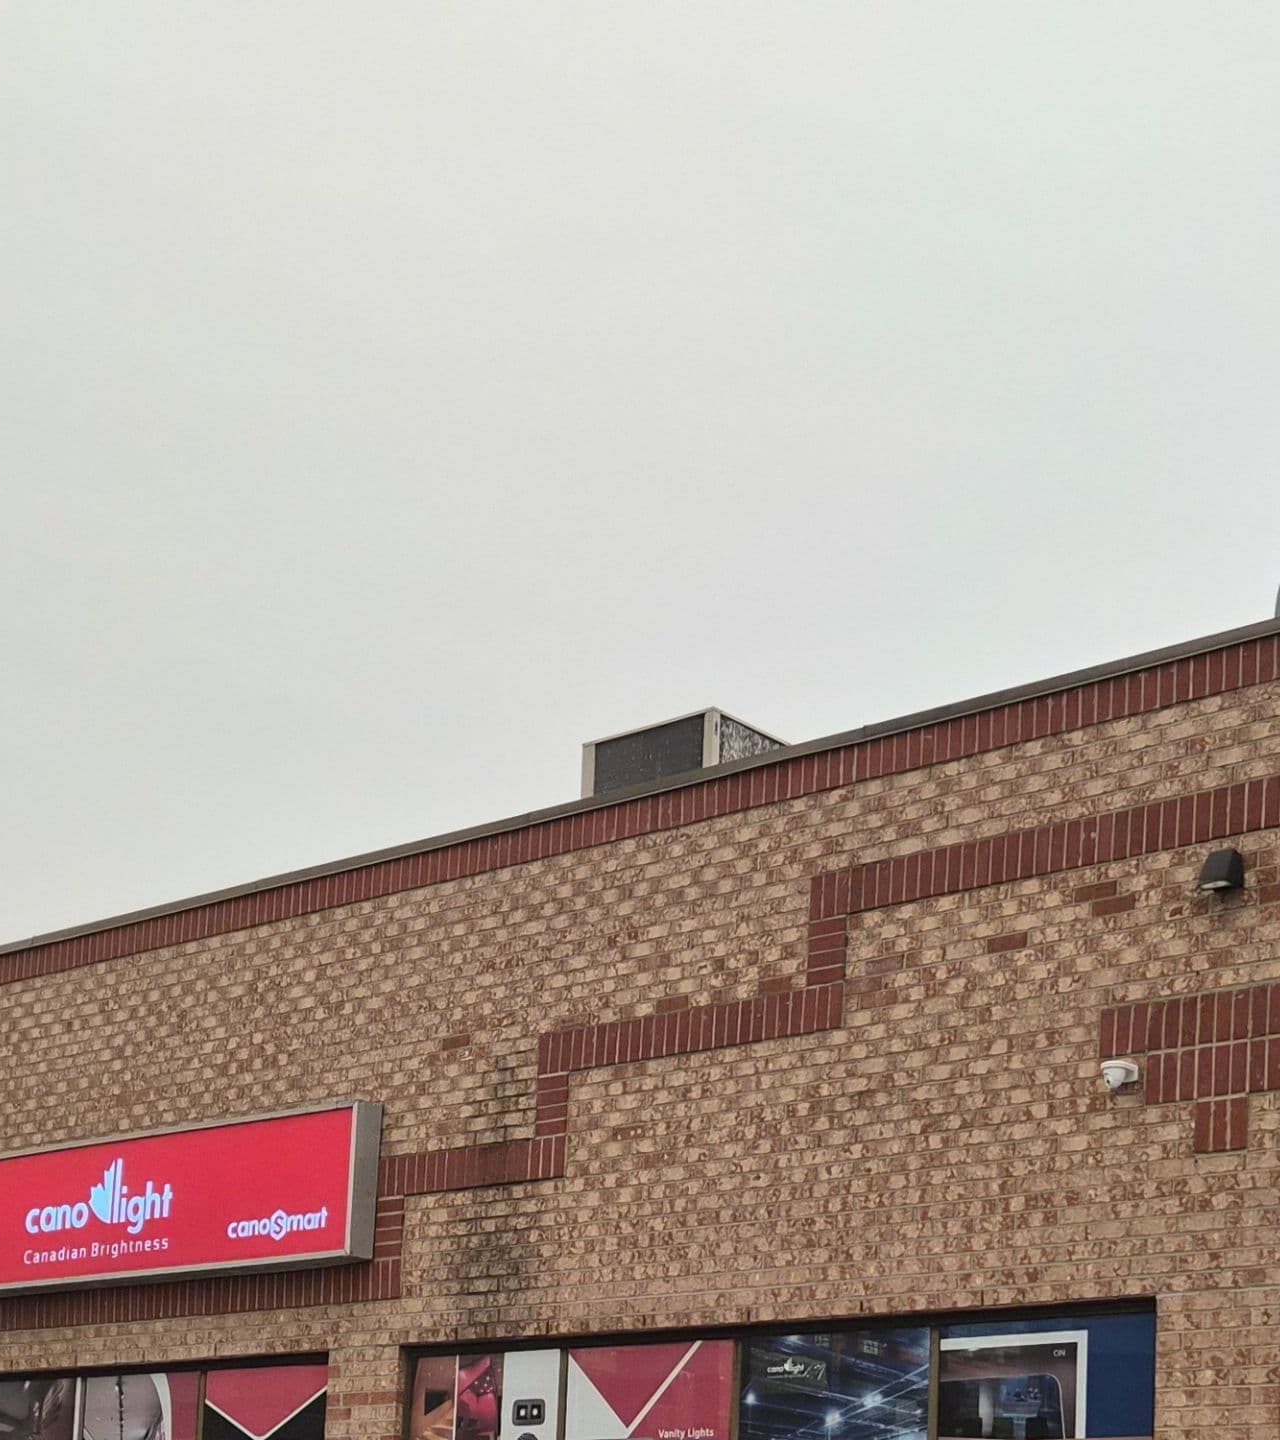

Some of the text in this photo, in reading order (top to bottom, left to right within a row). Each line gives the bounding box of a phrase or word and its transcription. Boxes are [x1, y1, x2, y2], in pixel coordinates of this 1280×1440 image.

[24, 1237, 170, 1265] Canadian Brightness
[658, 1427, 715, 1440] Vanity Lights
